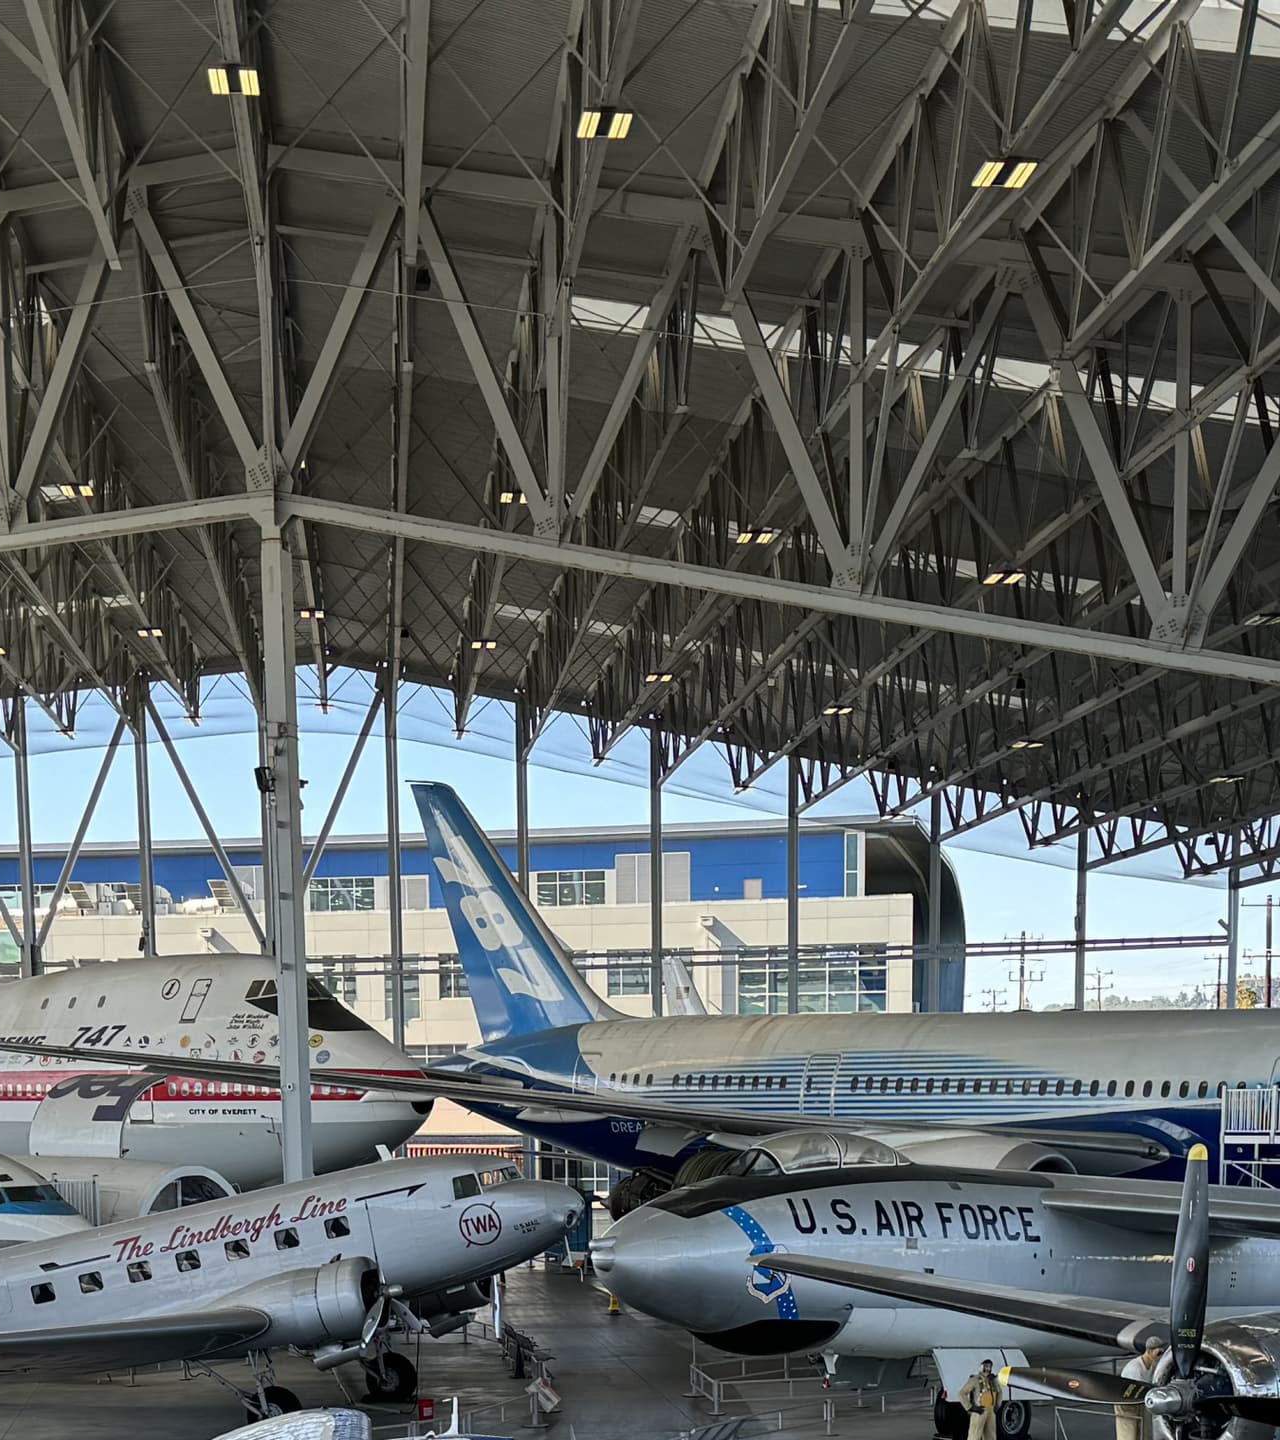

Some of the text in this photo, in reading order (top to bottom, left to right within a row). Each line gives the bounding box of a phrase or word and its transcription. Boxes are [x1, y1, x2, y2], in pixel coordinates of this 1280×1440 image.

[70, 1025, 127, 1048] 747
[222, 1108, 257, 1116] EVERETT
[113, 1195, 348, 1263] The Lindbergh Line
[463, 1213, 499, 1237] TWA
[875, 1199, 927, 1238] AIR
[935, 1202, 1042, 1243] FORCE
